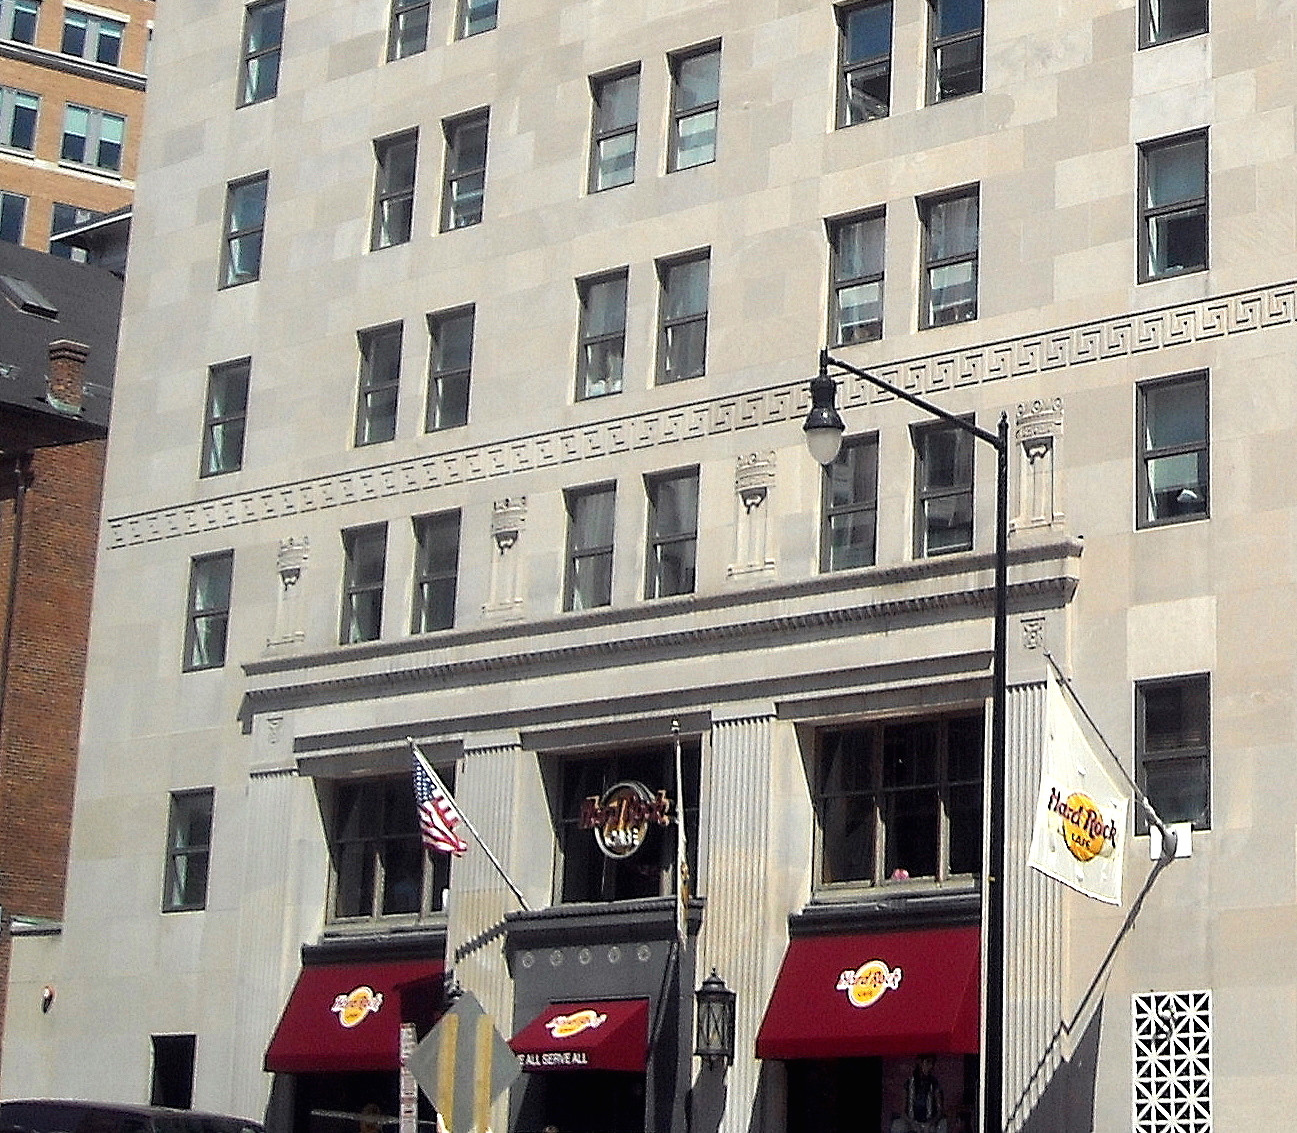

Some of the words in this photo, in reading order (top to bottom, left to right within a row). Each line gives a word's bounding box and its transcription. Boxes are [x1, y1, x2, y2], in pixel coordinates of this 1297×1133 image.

[1048, 786, 1082, 827] Hard
[1083, 809, 1117, 849] Rock
[524, 1053, 541, 1066] ALL
[541, 1052, 572, 1065] SERVE
[572, 1052, 588, 1065] ALL
